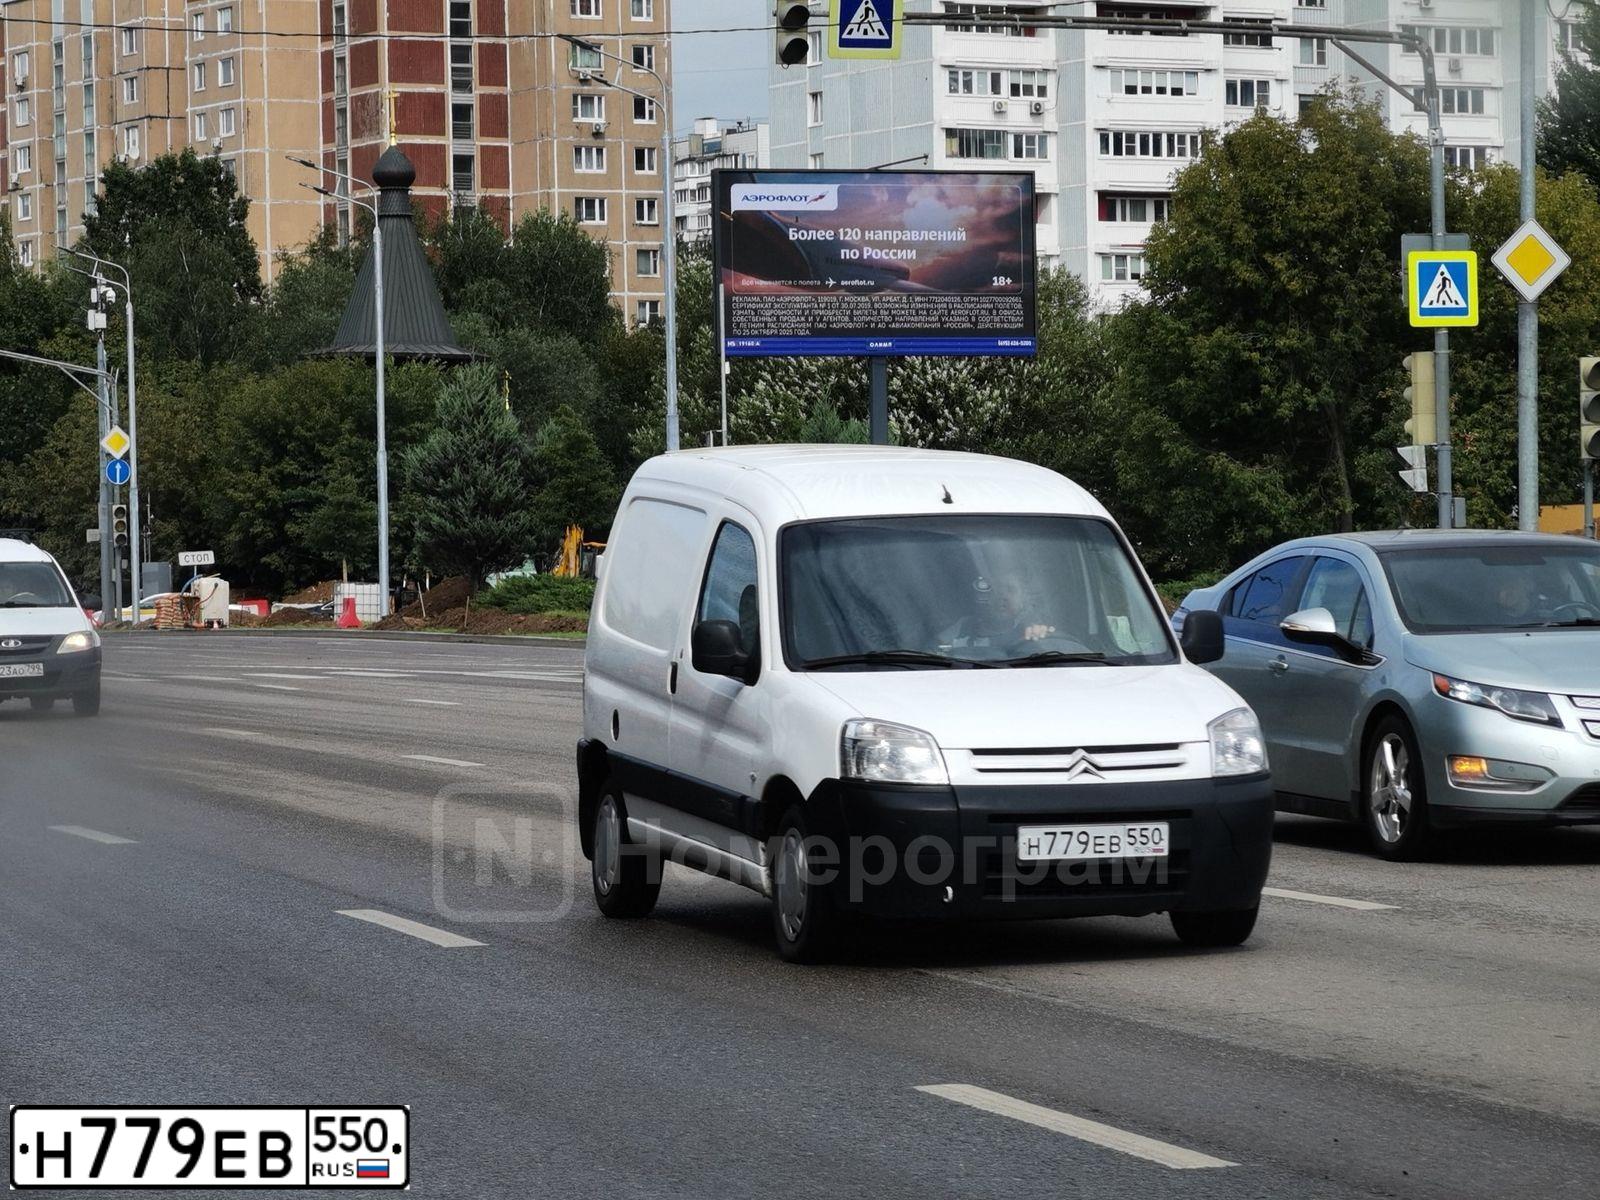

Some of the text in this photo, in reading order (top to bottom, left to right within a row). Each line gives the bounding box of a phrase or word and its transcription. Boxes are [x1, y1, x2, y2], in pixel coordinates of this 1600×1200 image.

[741, 194, 810, 203] АЭРОФЛОТ
[788, 227, 967, 245] Более 120 направлений
[841, 247, 917, 260] по России
[992, 276, 1013, 286] 18+
[184, 553, 210, 563] СТОП
